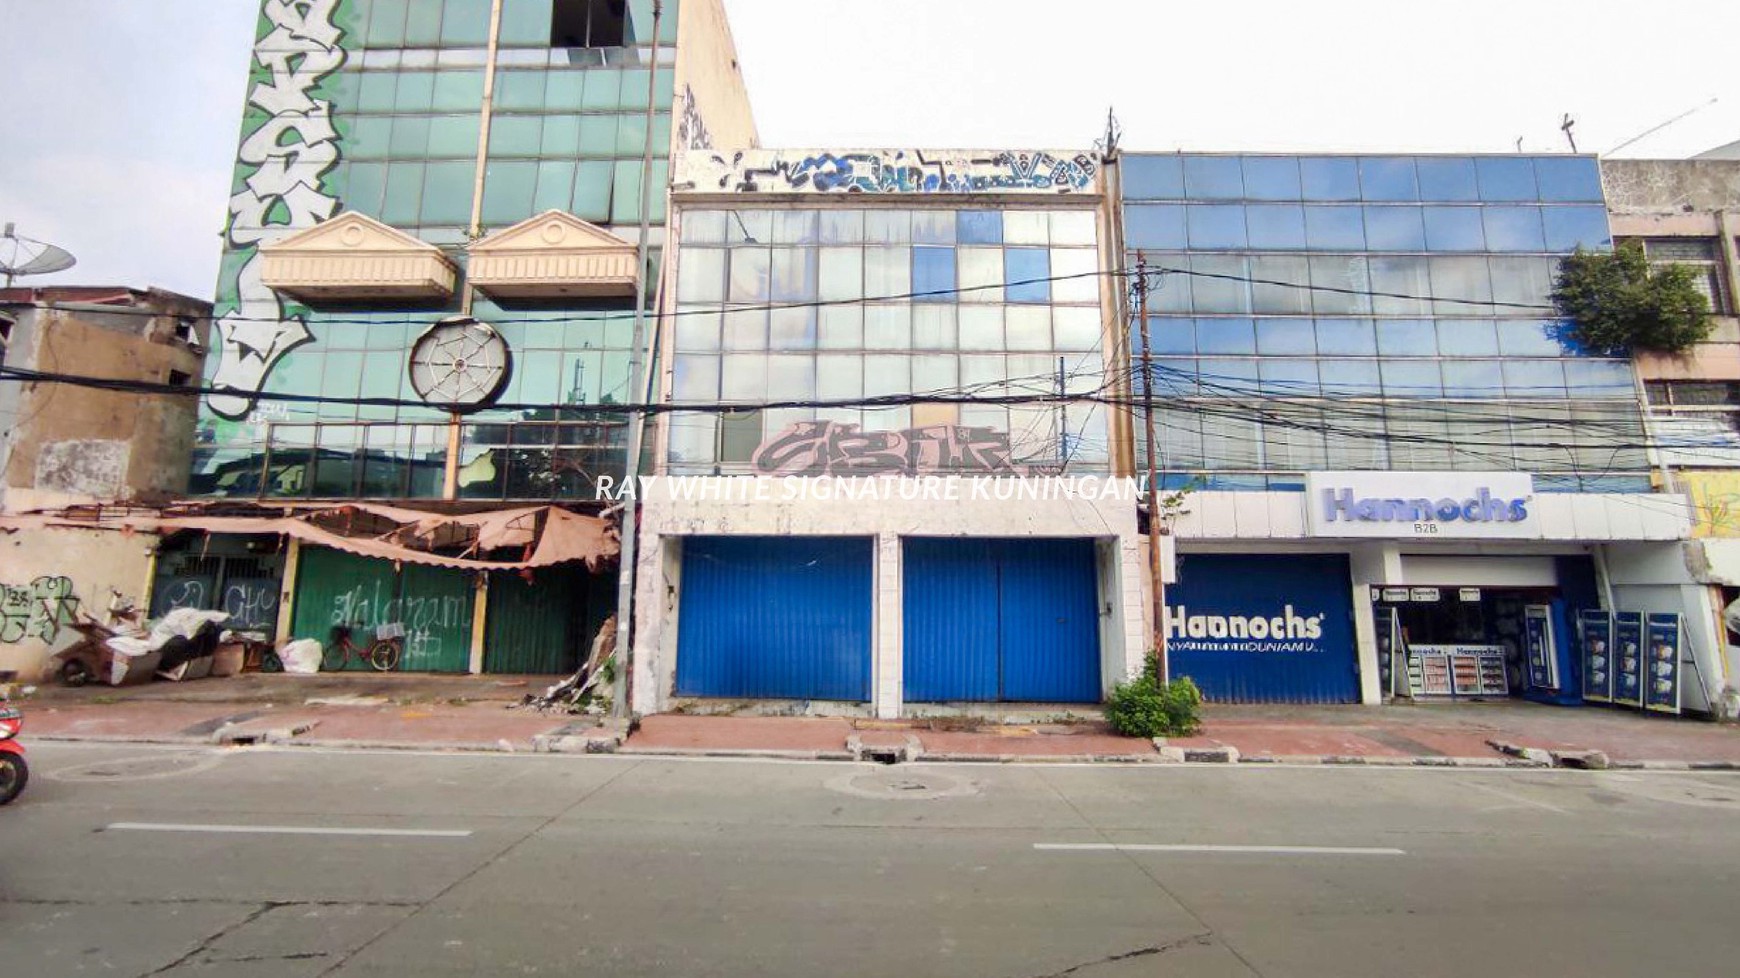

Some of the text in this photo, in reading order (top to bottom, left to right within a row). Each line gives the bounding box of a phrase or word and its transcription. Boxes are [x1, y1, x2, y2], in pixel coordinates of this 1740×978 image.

[1322, 487, 1528, 522] Hannochs
[1413, 523, 1438, 533] B2B
[1165, 604, 1322, 640] Hannochs
